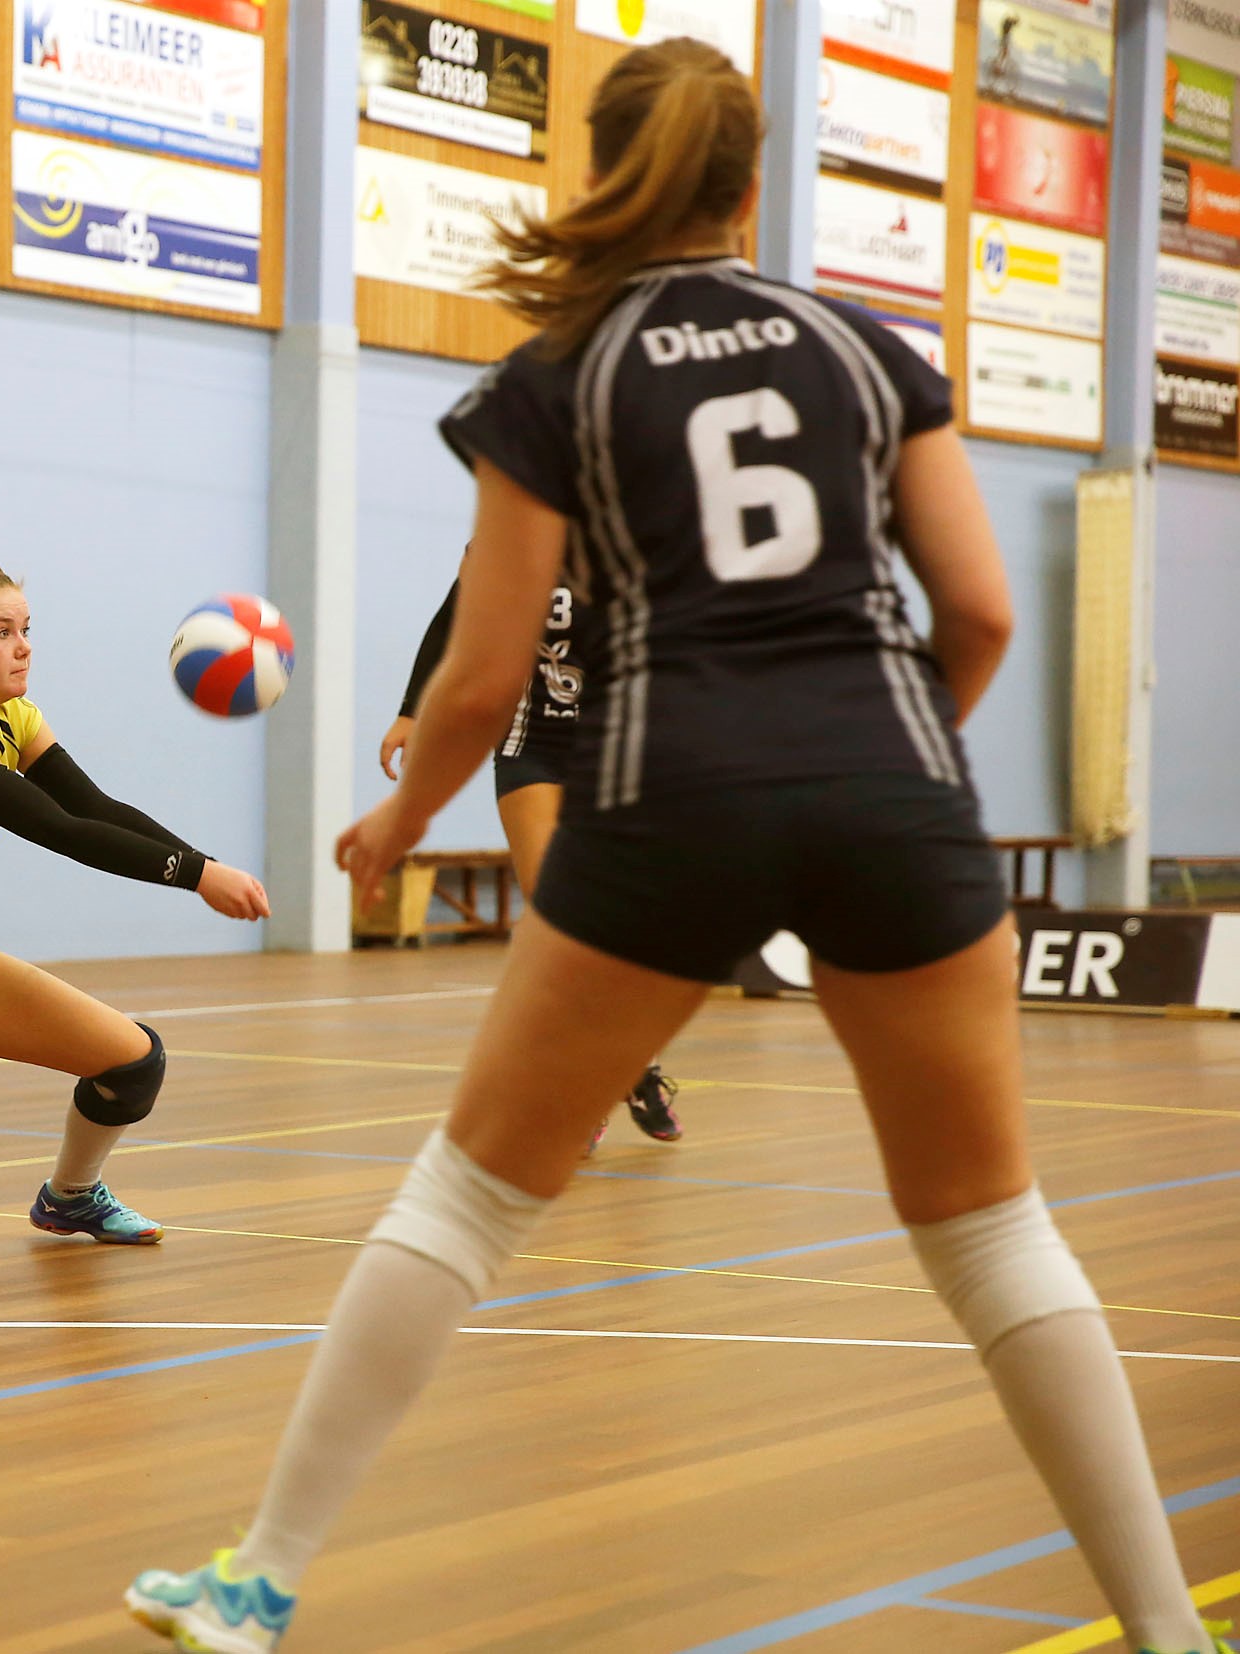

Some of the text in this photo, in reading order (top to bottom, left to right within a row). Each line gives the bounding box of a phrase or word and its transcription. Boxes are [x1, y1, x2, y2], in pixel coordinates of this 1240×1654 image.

[78, 8, 205, 68] LEIMEER
[640, 316, 799, 367] Dinto
[686, 387, 823, 583] 6
[546, 586, 572, 630] 3
[1022, 928, 1126, 999] ER
